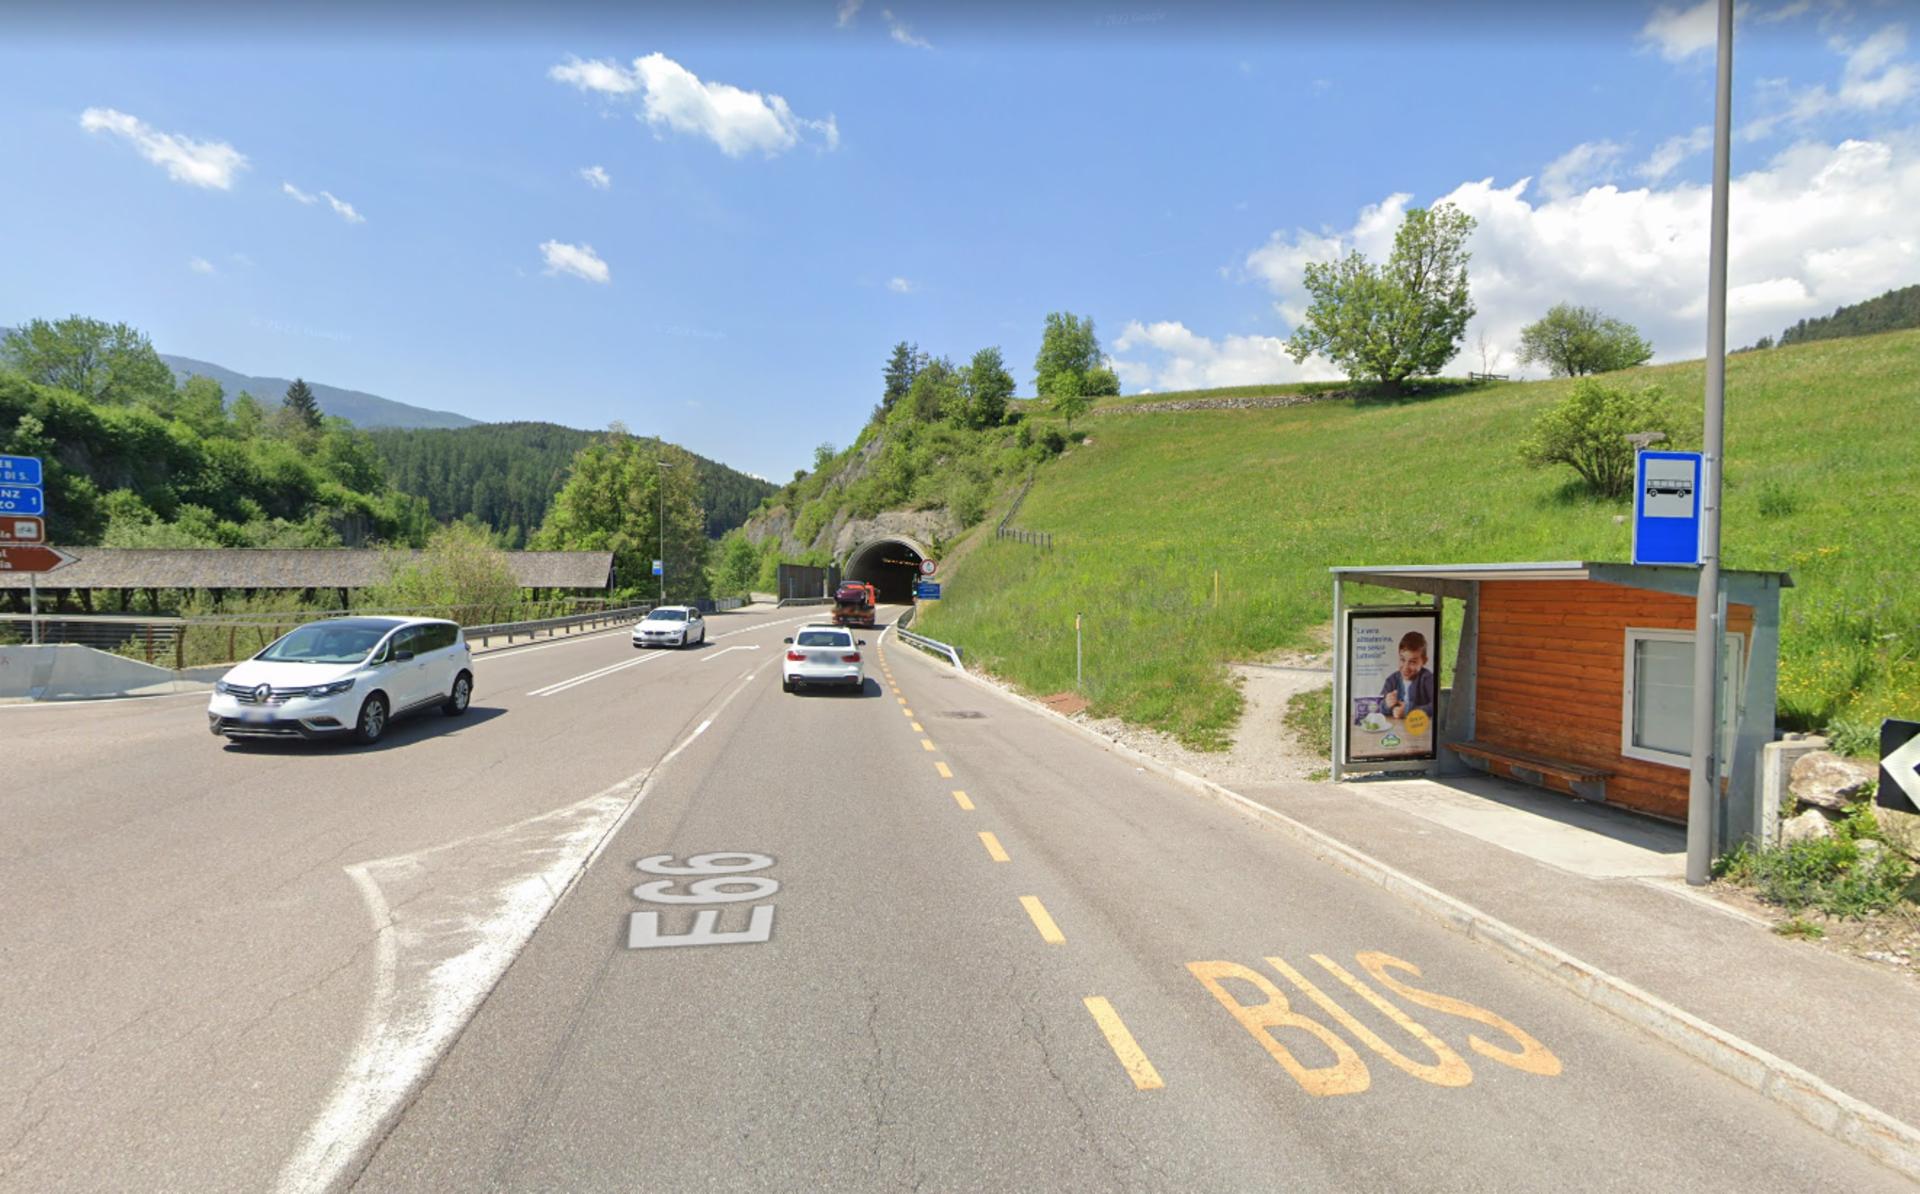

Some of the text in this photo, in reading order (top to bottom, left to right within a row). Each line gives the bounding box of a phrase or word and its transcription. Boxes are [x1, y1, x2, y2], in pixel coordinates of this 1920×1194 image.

[5, 471, 16, 480] DI
[31, 496, 37, 505] 1
[628, 851, 780, 949] E66
[1184, 950, 1563, 1097] BUS
